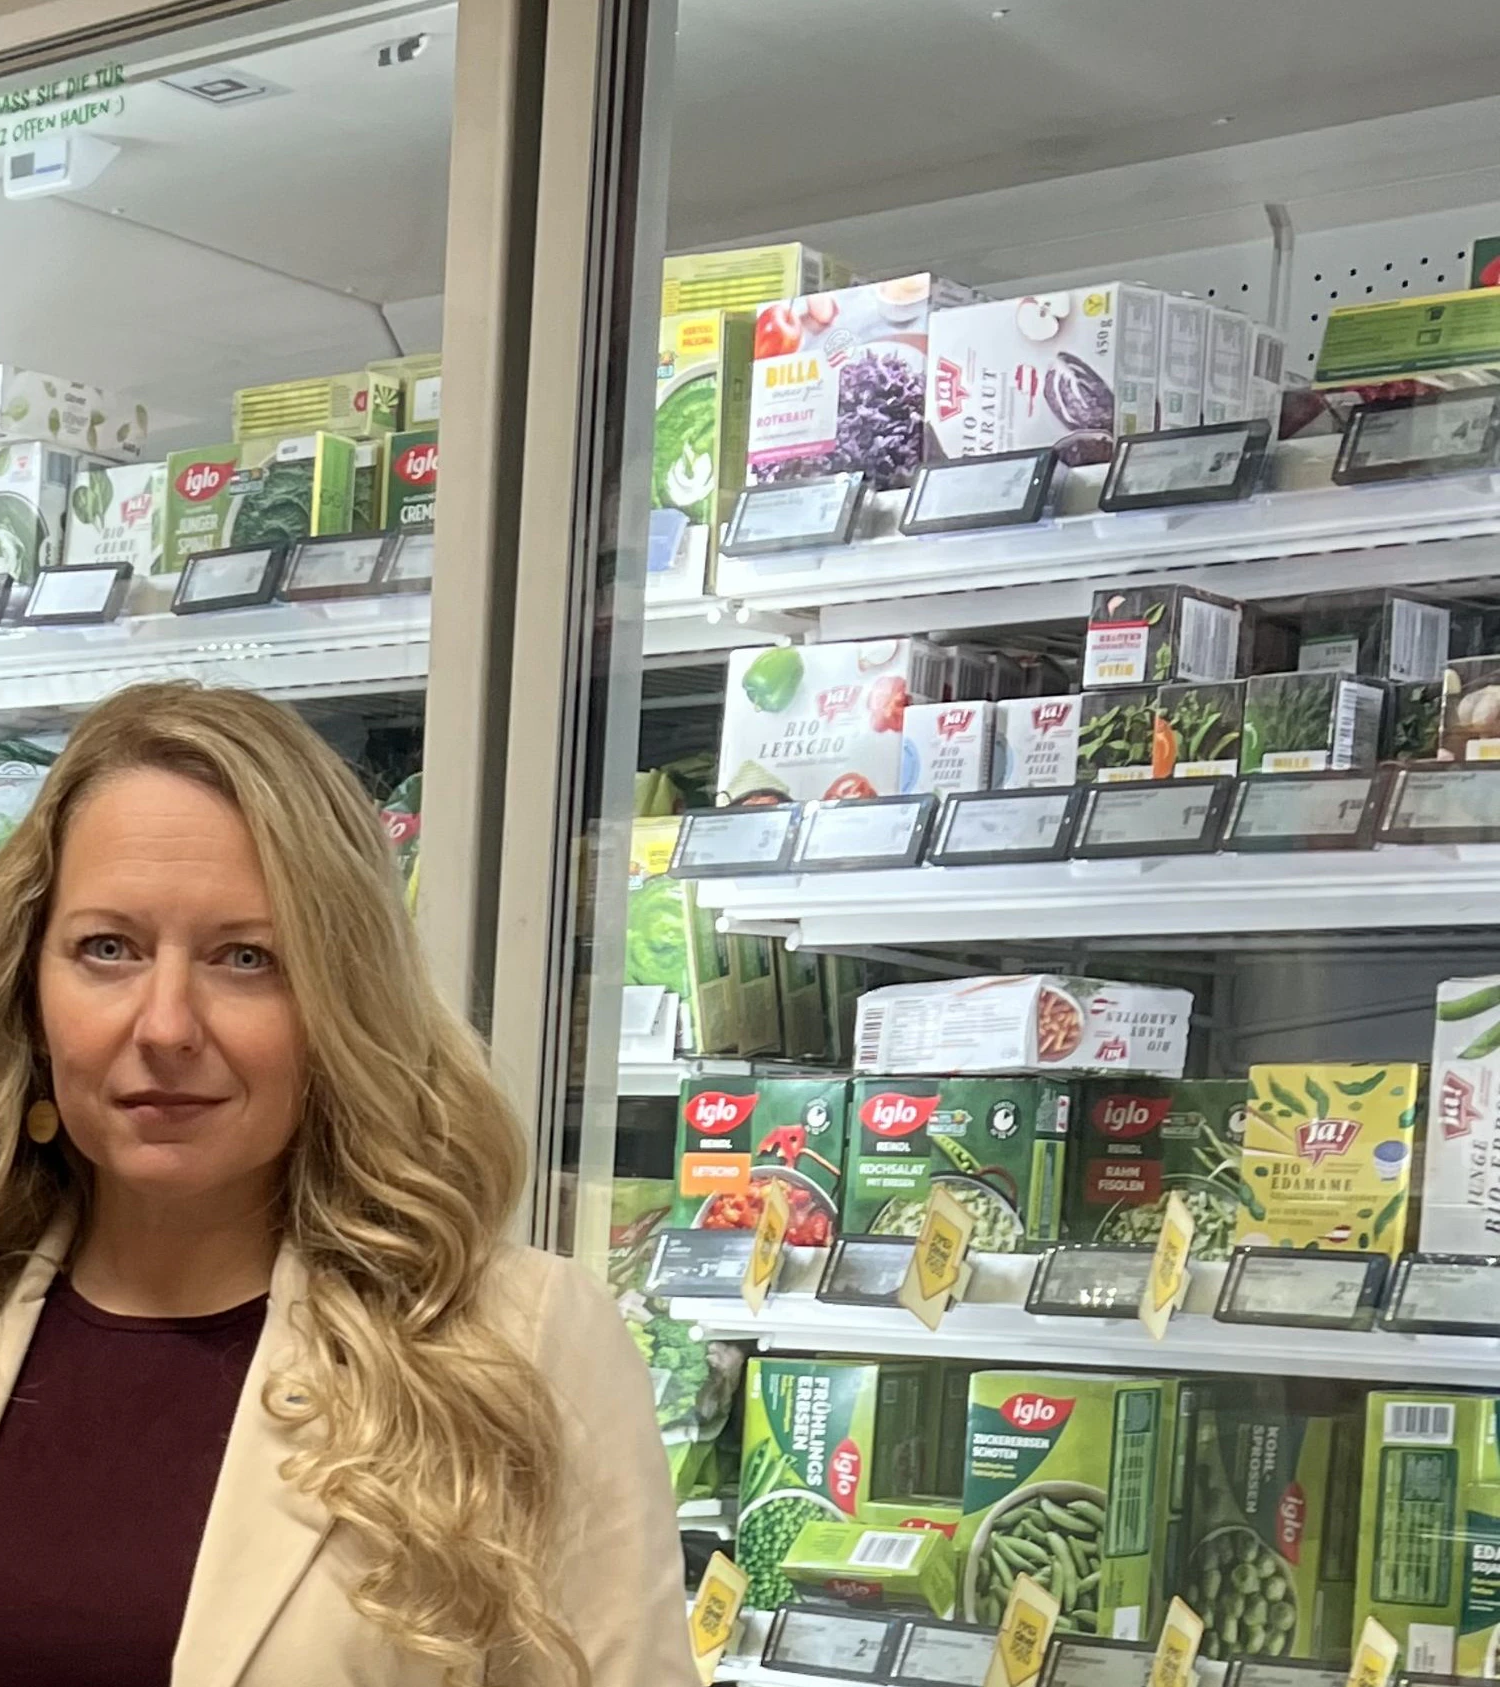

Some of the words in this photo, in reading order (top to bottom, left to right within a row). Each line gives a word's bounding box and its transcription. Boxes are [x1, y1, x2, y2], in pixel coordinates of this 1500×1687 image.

[36, 84, 60, 106] SIE
[66, 73, 89, 99] DIE
[94, 64, 125, 88] TÜR
[12, 114, 56, 142] OFFEN
[60, 99, 110, 128] HALTEN
[765, 357, 819, 389] BILLA
[185, 465, 220, 497] iglo
[400, 502, 437, 524] CREM
[102, 526, 125, 540] BIO
[825, 686, 852, 707] ja!
[947, 707, 969, 727] ja!
[1040, 702, 1066, 721] ja!
[783, 720, 821, 738] BIO
[758, 736, 846, 760] LETSCHO
[938, 746, 961, 758] BIO
[696, 1098, 738, 1128] iglo
[872, 1098, 918, 1129] iglo
[1103, 1100, 1150, 1132] iglo
[1306, 1120, 1347, 1144] ja!
[859, 1163, 926, 1176] KOCHSALAT
[1105, 1165, 1141, 1179] RAHM
[1273, 1162, 1301, 1176] BIO
[1467, 1139, 1488, 1206] JUNGE
[1098, 1178, 1145, 1193] FISOLEN
[1271, 1177, 1353, 1192] EDAMAME
[791, 1375, 814, 1451] ERBSEN
[1012, 1396, 1056, 1425] iglo
[1262, 1425, 1280, 1483] KOHL-
[833, 1452, 860, 1497] iglo
[1245, 1424, 1266, 1514] SPROSSEN
[1280, 1495, 1304, 1543] iglo
